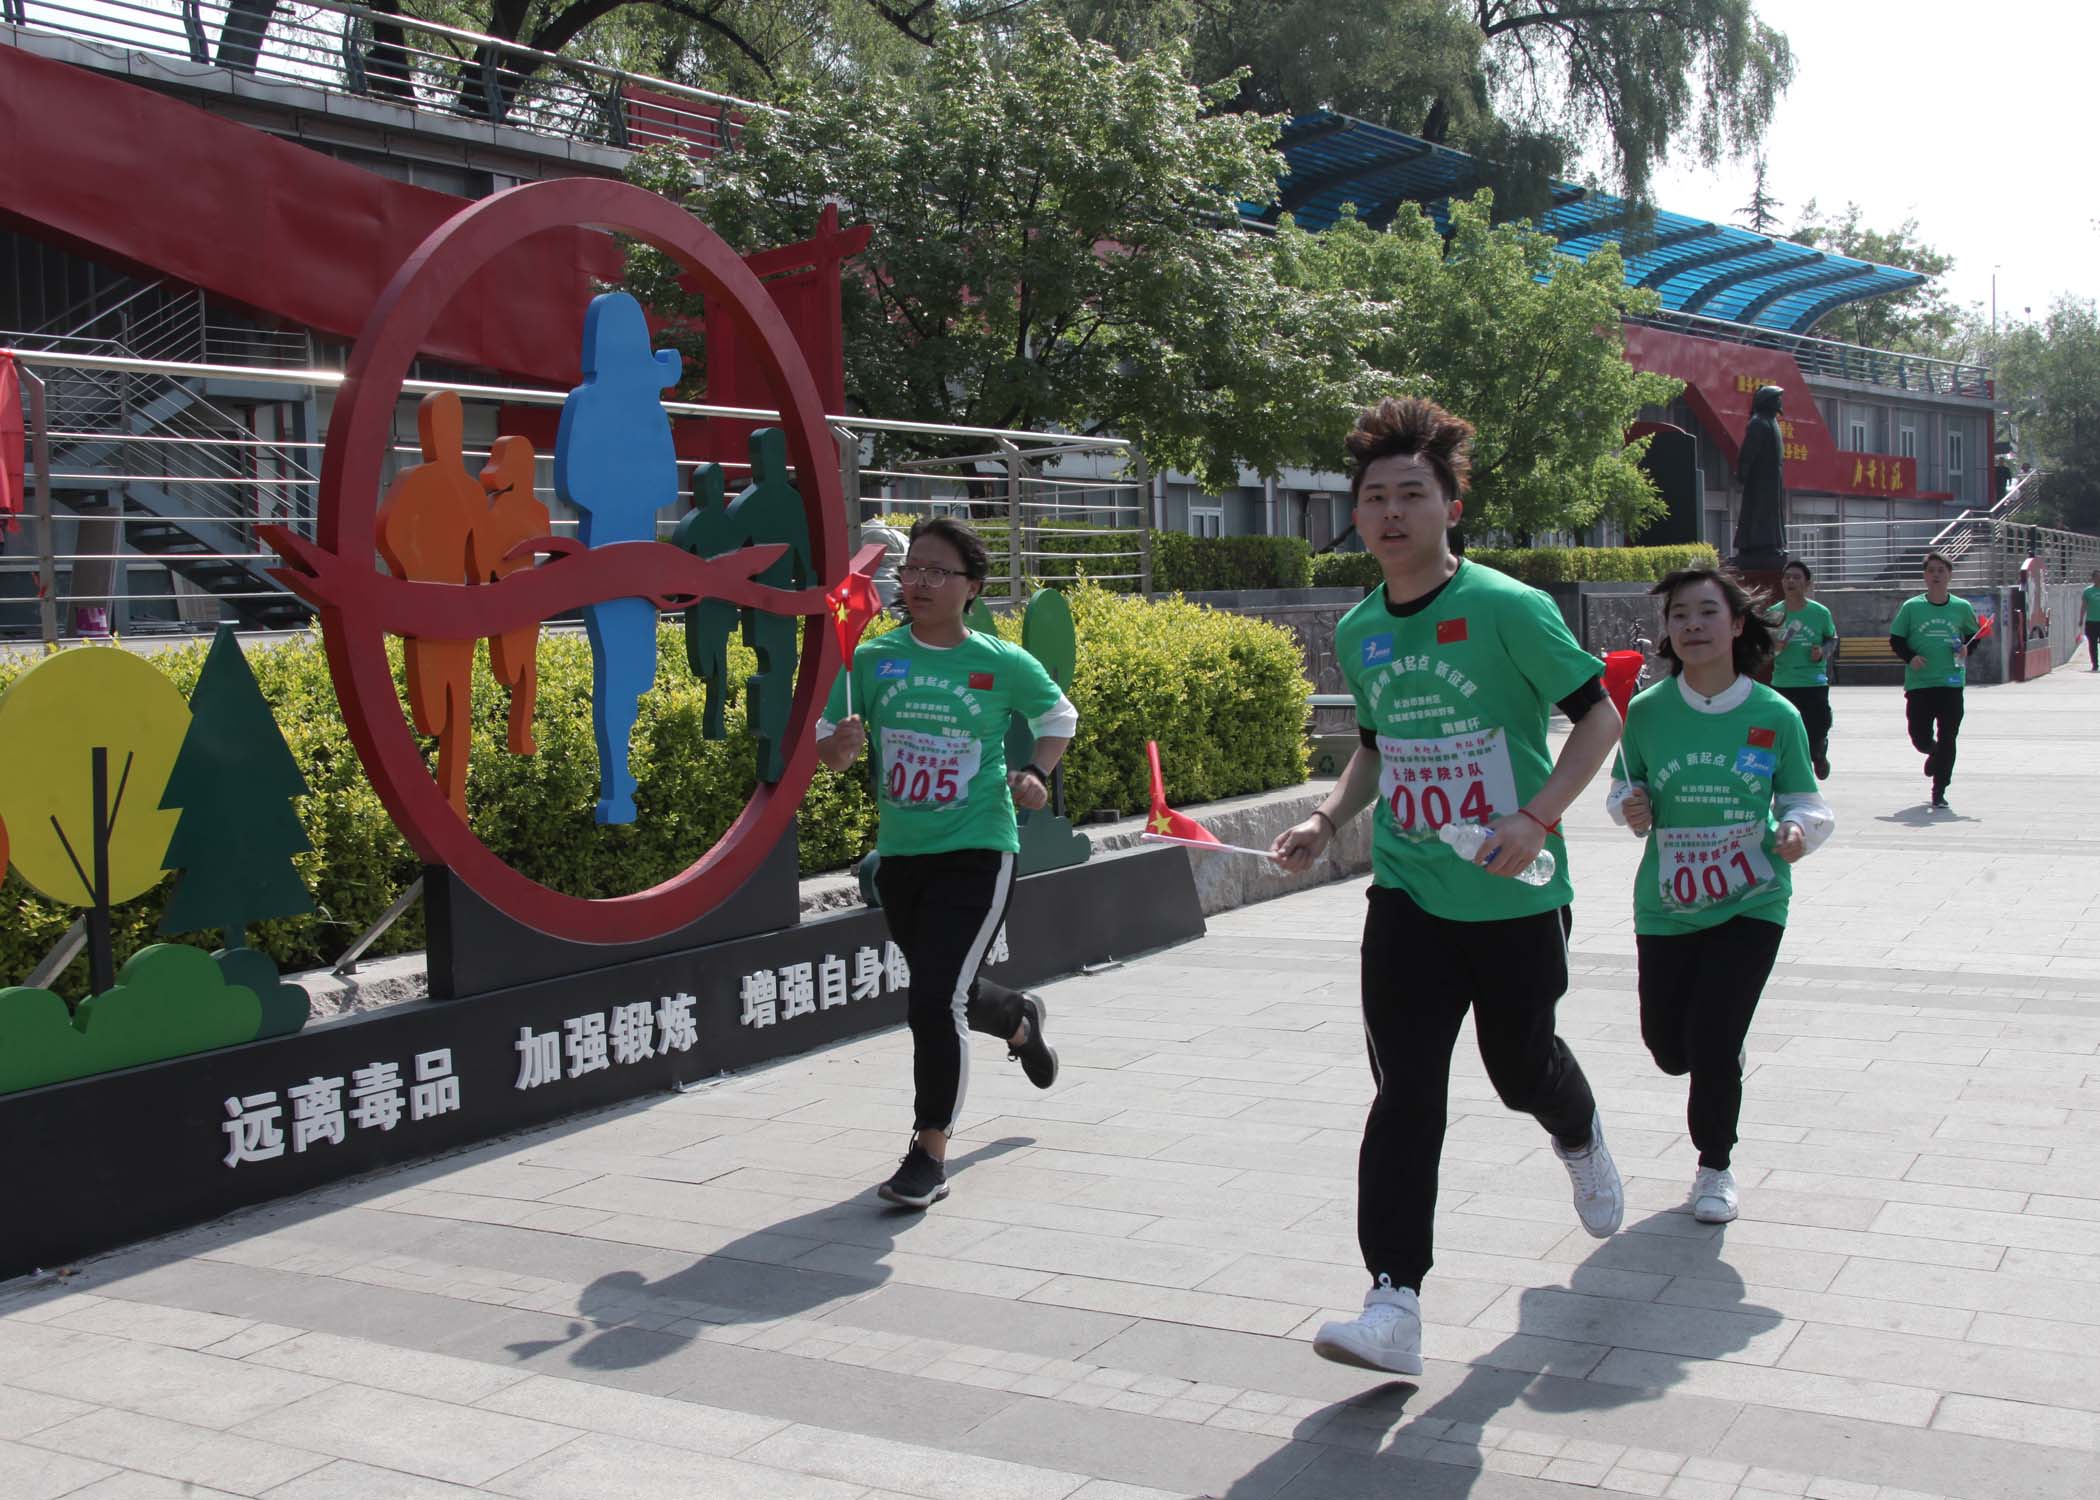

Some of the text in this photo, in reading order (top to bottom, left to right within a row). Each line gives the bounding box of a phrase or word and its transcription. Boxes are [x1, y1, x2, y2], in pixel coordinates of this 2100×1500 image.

[890, 762, 960, 804] 005
[1390, 780, 1494, 831] 004
[1673, 851, 1758, 905] 001
[222, 1048, 460, 1168] 远离毒品
[514, 993, 699, 1091] 加强锻炼
